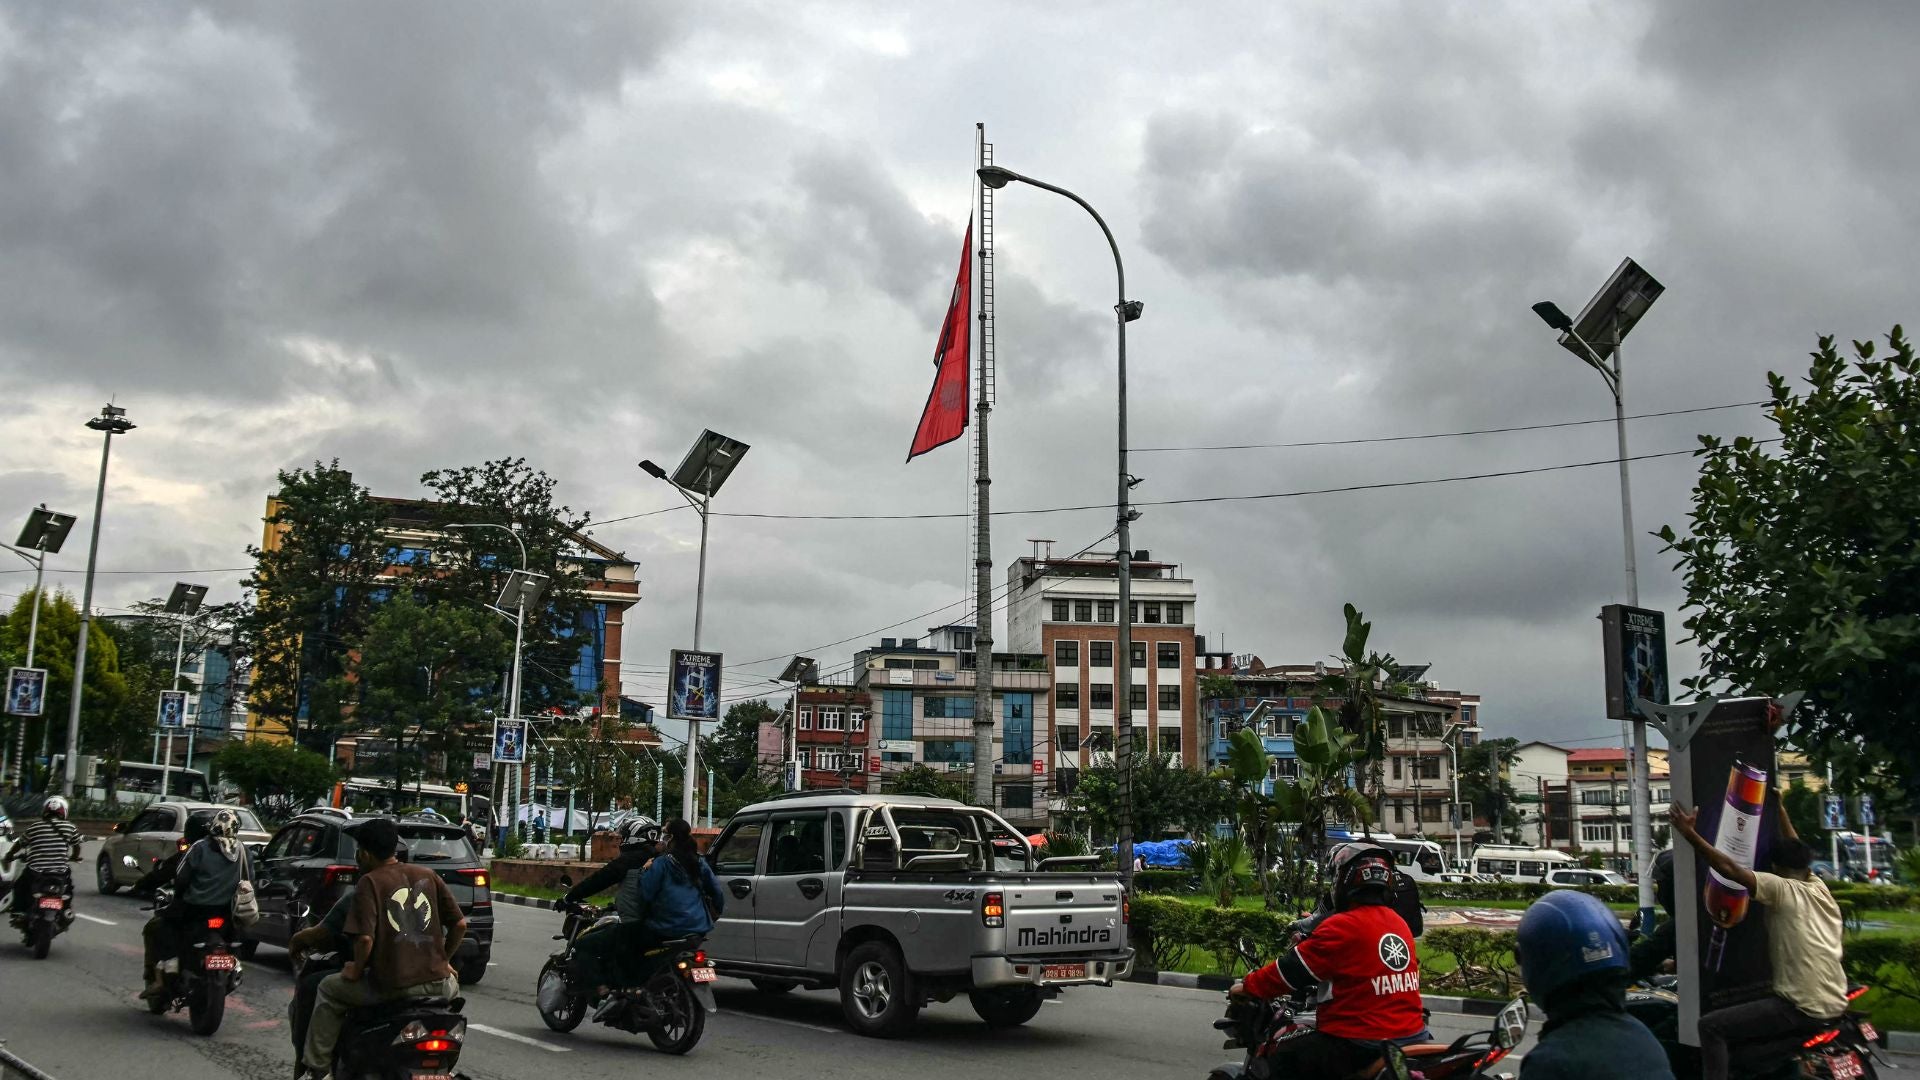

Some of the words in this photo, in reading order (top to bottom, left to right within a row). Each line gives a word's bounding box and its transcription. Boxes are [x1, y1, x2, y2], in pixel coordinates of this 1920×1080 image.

[1627, 612, 1654, 627] XTREME
[683, 653, 711, 664] XTREME
[944, 889, 976, 901] 4x4
[1018, 925, 1110, 946] Mahindra
